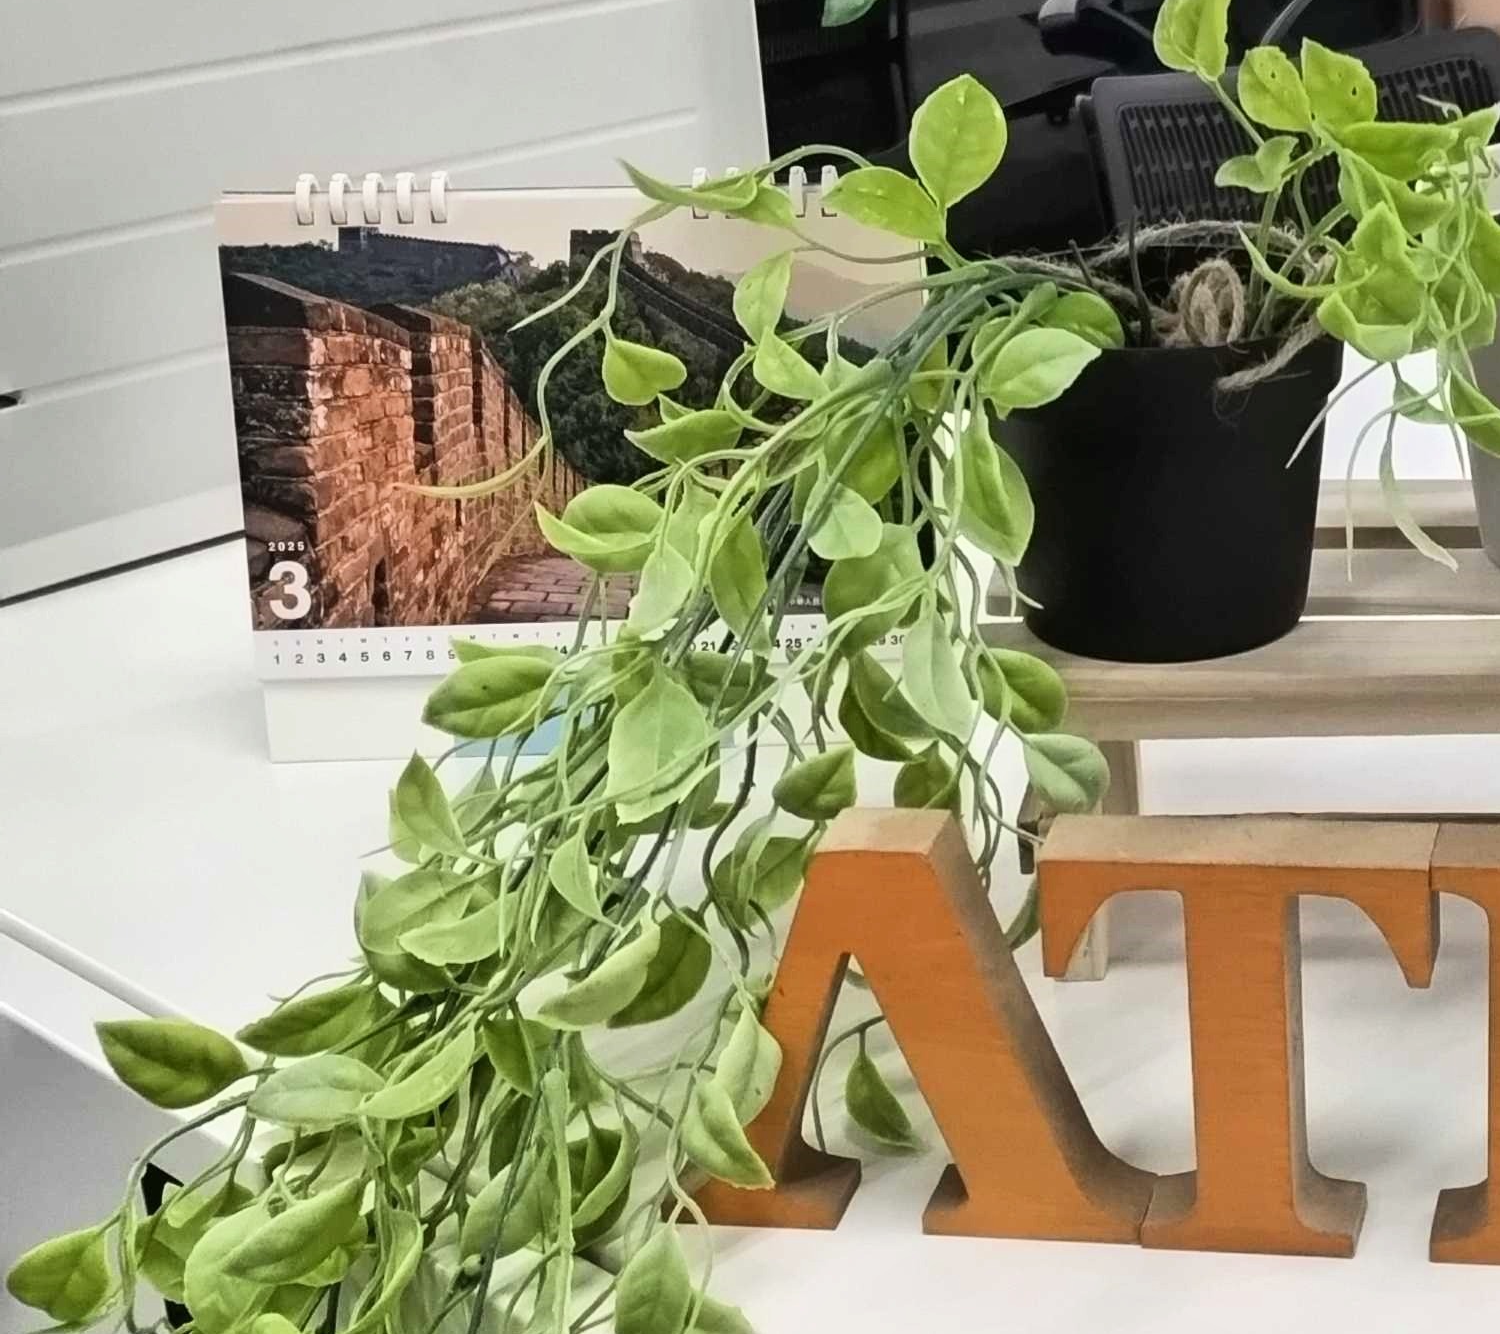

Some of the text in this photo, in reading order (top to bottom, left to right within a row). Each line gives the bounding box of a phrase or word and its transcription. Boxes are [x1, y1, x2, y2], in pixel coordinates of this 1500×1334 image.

[268, 541, 305, 552] 2025
[269, 561, 312, 620] 3
[274, 654, 280, 664] 1
[295, 654, 304, 664] 2
[316, 653, 325, 663] 3
[338, 652, 347, 662] 4
[360, 652, 369, 662] 5
[382, 651, 391, 661] 6
[404, 651, 412, 660] 7
[426, 650, 434, 660] 8
[701, 641, 716, 651] 21
[786, 638, 802, 648] 25
